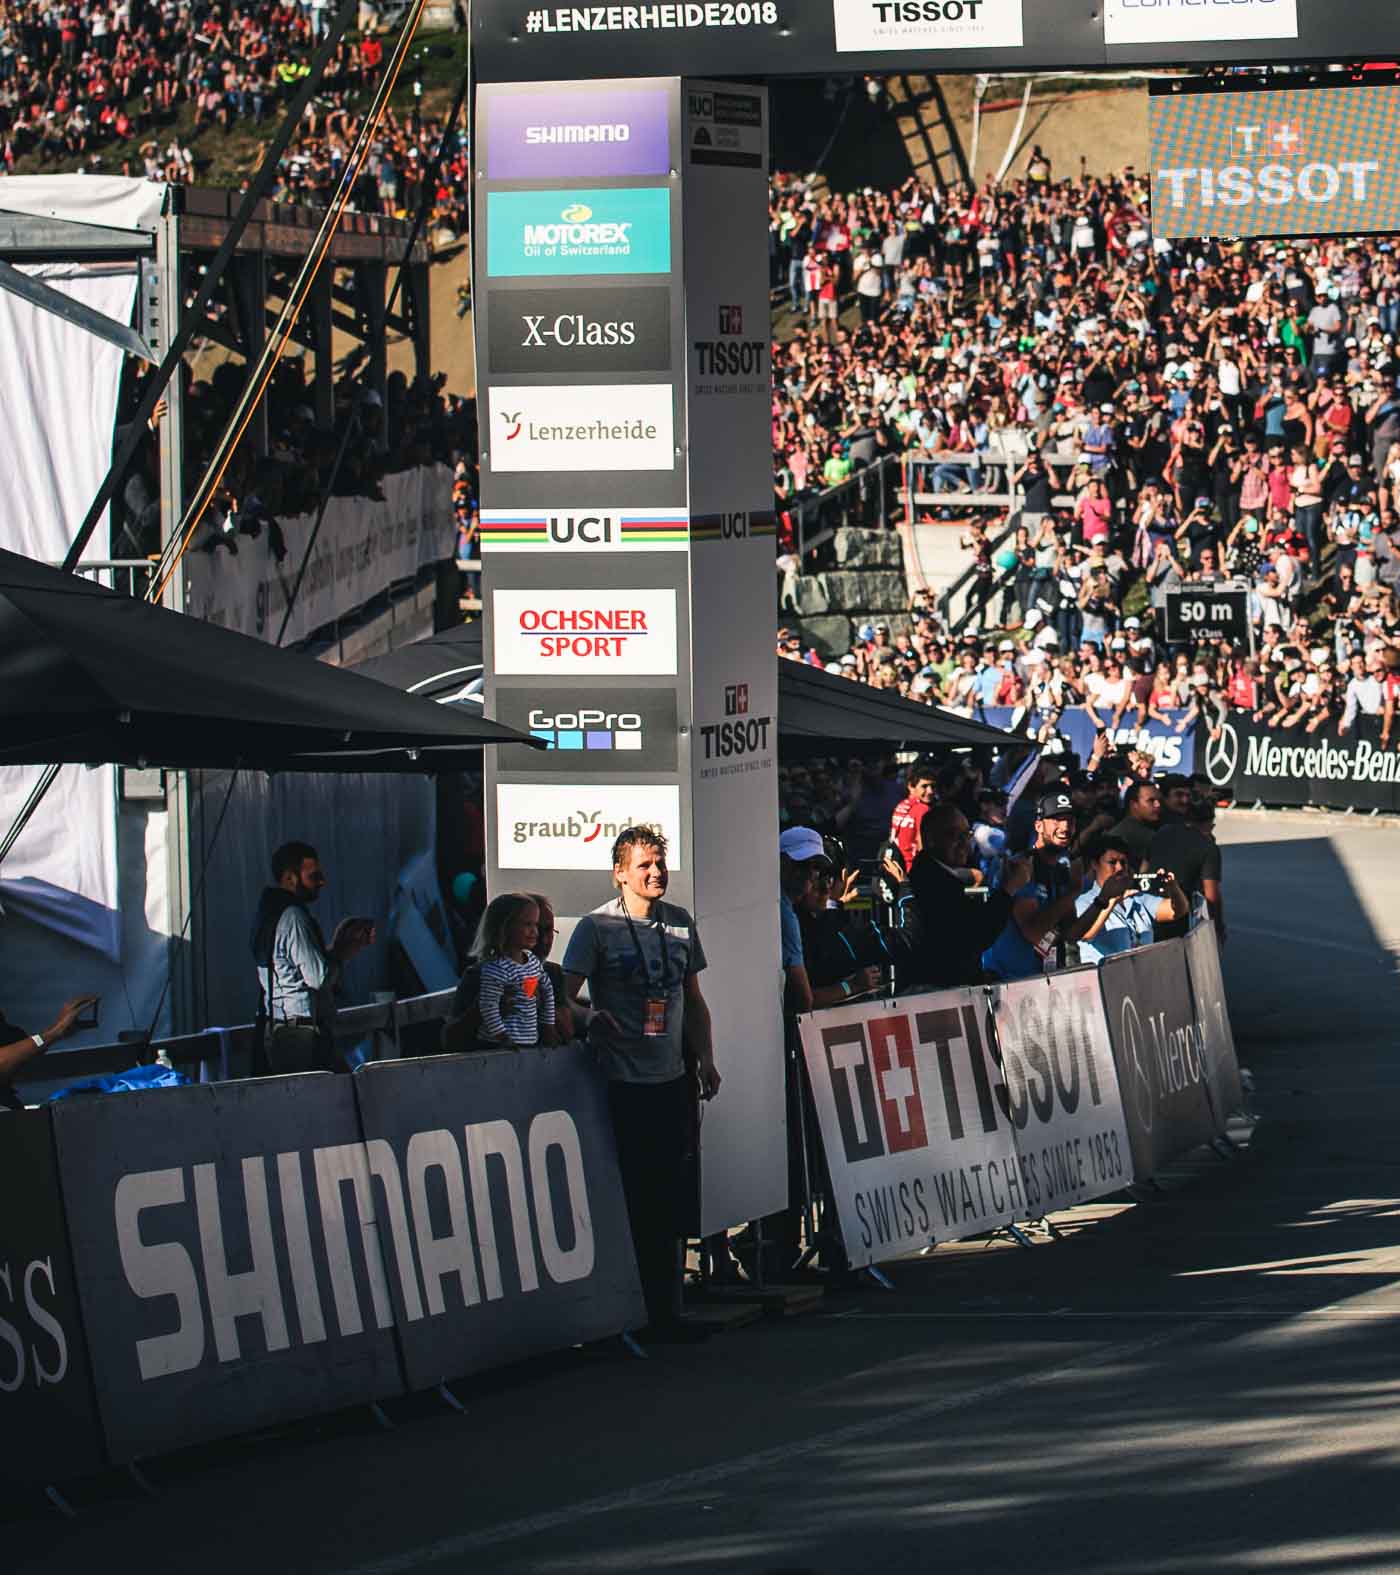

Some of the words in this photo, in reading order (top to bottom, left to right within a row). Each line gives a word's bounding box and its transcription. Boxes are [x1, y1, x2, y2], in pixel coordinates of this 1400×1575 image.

[526, 2, 778, 33] #LENZERHEIDE2018
[872, 0, 983, 22] TISSOT
[525, 124, 630, 144] SHIMANO
[1158, 161, 1379, 208] TISSOT
[524, 223, 630, 245] MOTOREX
[524, 245, 541, 257] Oil
[545, 245, 557, 256] of
[560, 244, 630, 256] Switzerland
[522, 315, 635, 346] X-Class
[694, 342, 764, 375] TISSOT
[529, 420, 657, 441] Lenzerheide
[550, 517, 612, 543] UCI
[721, 512, 747, 539] UCI
[519, 609, 648, 631] OCHSNER
[1180, 601, 1206, 622] 50
[1211, 603, 1233, 620] m
[540, 637, 627, 657] SPORT
[528, 710, 642, 730] GoPro
[700, 717, 771, 758] TISSOT
[915, 985, 1102, 1140] TISSOT
[854, 1177, 930, 1249] SWISS
[933, 1152, 1041, 1226] WATCHES
[1041, 1138, 1086, 1199] SINCE
[1087, 1129, 1123, 1181] 1853
[114, 1109, 596, 1381] SHIMANO
